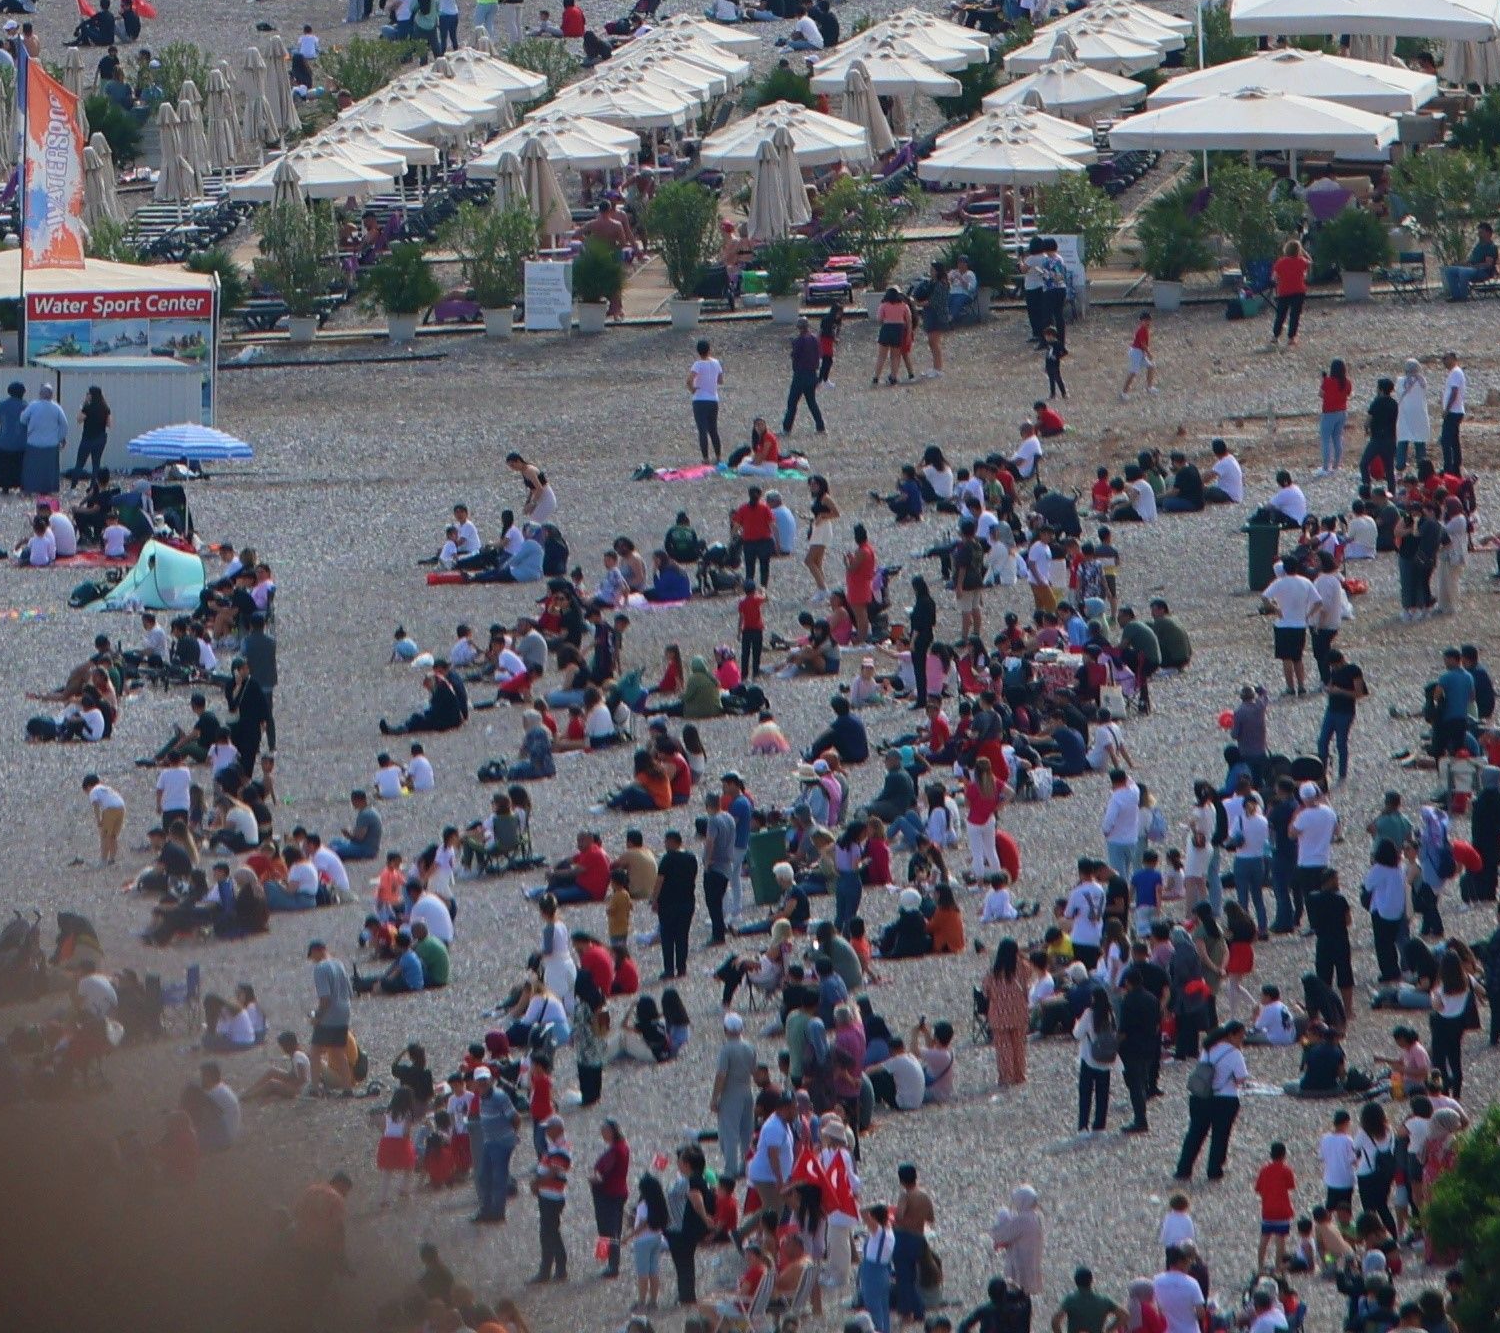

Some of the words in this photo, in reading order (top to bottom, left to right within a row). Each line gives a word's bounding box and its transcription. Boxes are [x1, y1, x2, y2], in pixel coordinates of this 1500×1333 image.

[34, 297, 88, 315] Water
[92, 296, 141, 317] Sport
[145, 295, 205, 313] Center
